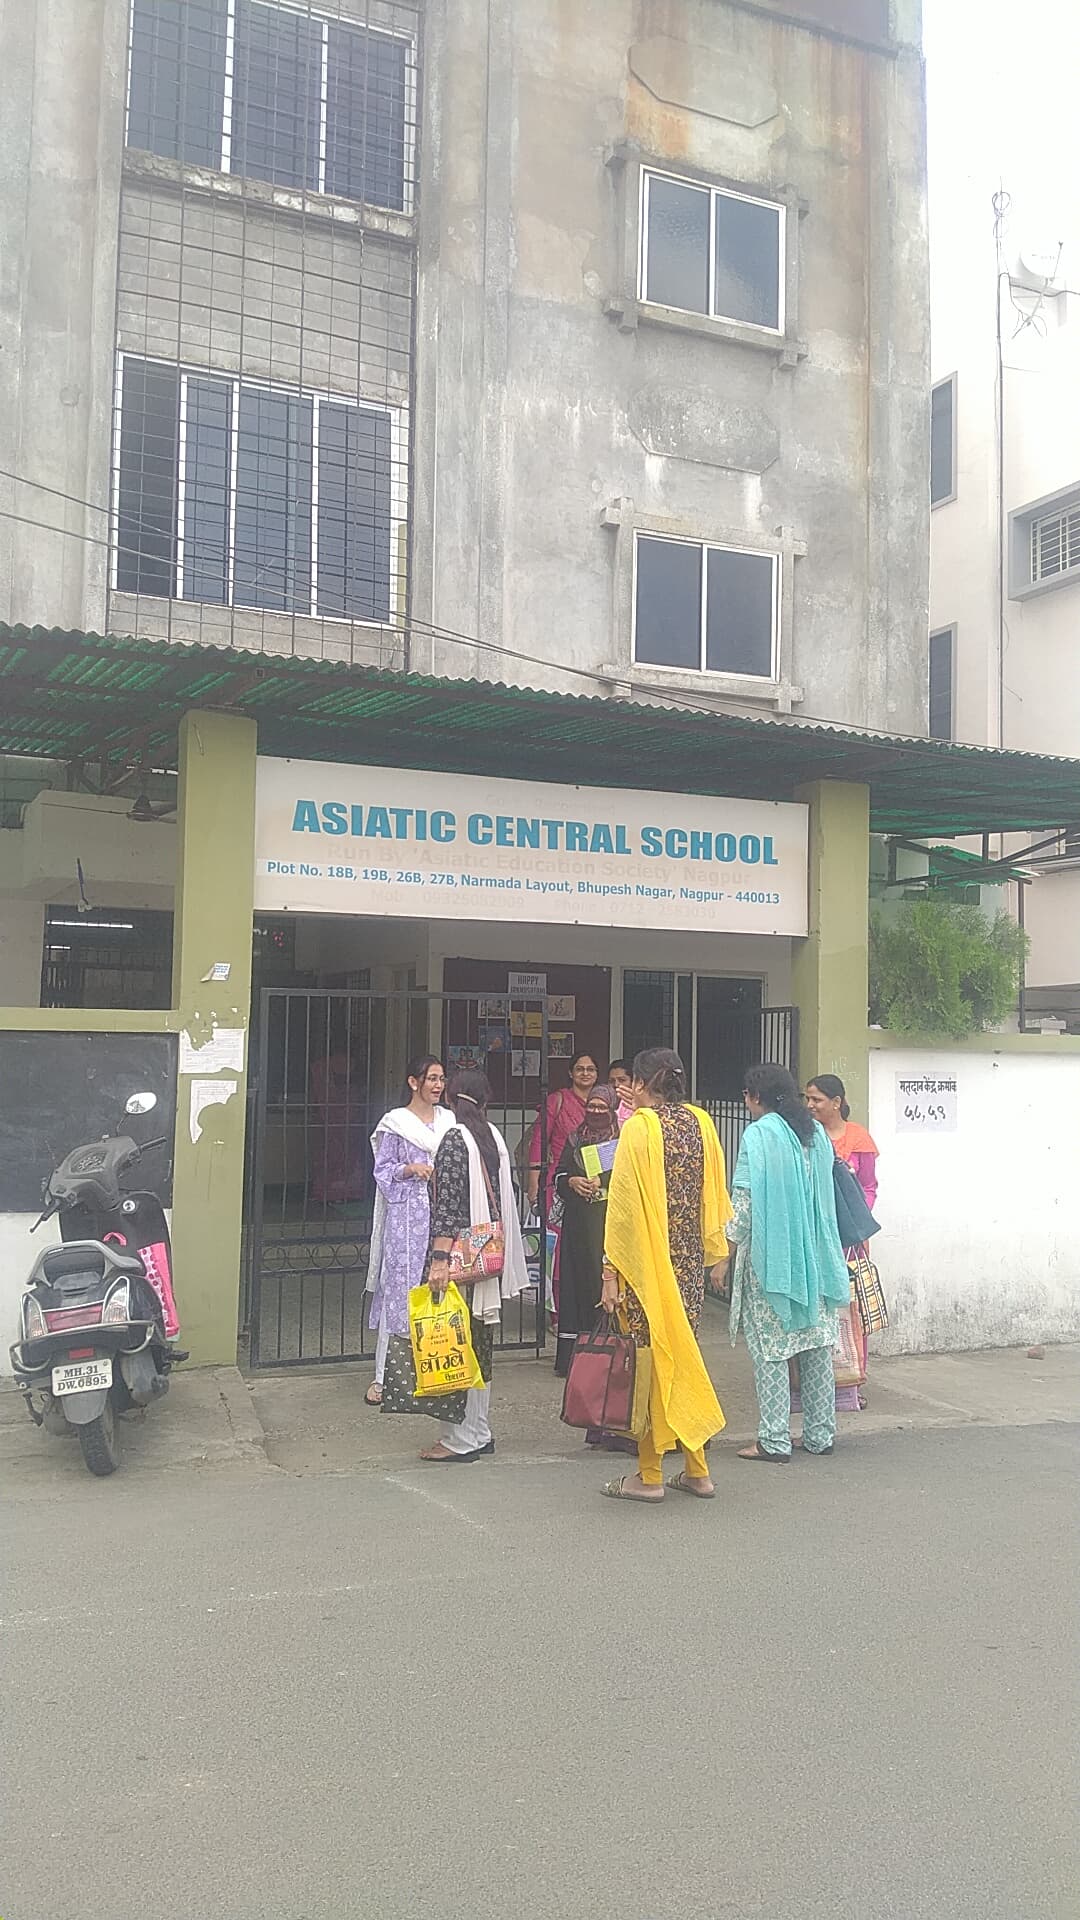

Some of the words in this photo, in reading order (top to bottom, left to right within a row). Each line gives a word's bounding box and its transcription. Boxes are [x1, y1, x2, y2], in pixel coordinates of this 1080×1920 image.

[291, 799, 457, 843] ASIATIC
[467, 812, 632, 856] CENTRAL
[640, 825, 779, 866] SCHOOL
[267, 860, 296, 876] Plot
[300, 863, 323, 878] No.
[327, 865, 357, 882] 18B,
[362, 867, 391, 884] 19B,
[396, 870, 425, 886] 26B,
[429, 872, 459, 888] 27B,
[460, 874, 522, 890] Narmada
[525, 877, 574, 894] Layout,
[577, 880, 632, 899] Bhupesh
[635, 884, 677, 900] Nagar,
[679, 886, 723, 904] Nagpur
[735, 891, 780, 904] 440013
[899, 1080, 924, 1096] मतदान
[924, 1075, 938, 1094] केंद्र
[937, 1077, 957, 1093] क्रमांक
[63, 1364, 99, 1379] MH.31
